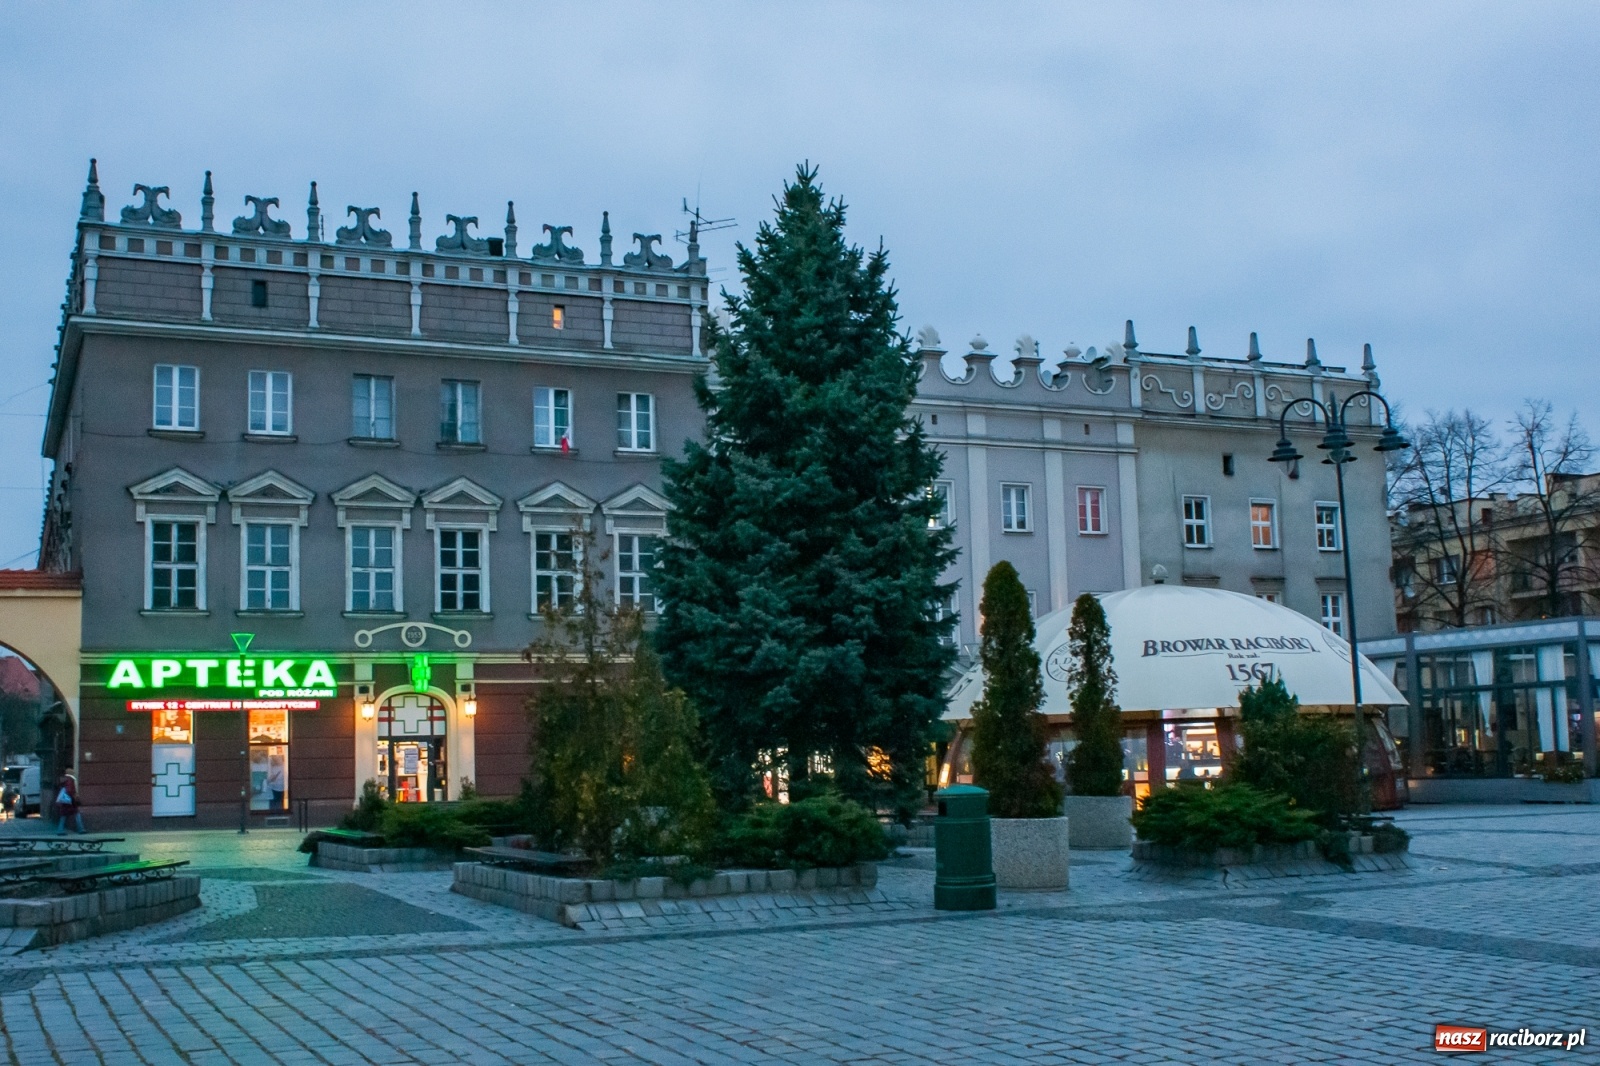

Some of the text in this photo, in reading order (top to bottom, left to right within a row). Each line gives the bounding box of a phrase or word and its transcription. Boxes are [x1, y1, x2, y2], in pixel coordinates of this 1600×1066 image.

[1141, 636, 1320, 657] BROWAR RACIBÓRZ
[108, 659, 337, 688] APTEKA
[1226, 663, 1274, 681] 1567
[259, 689, 284, 697] POD
